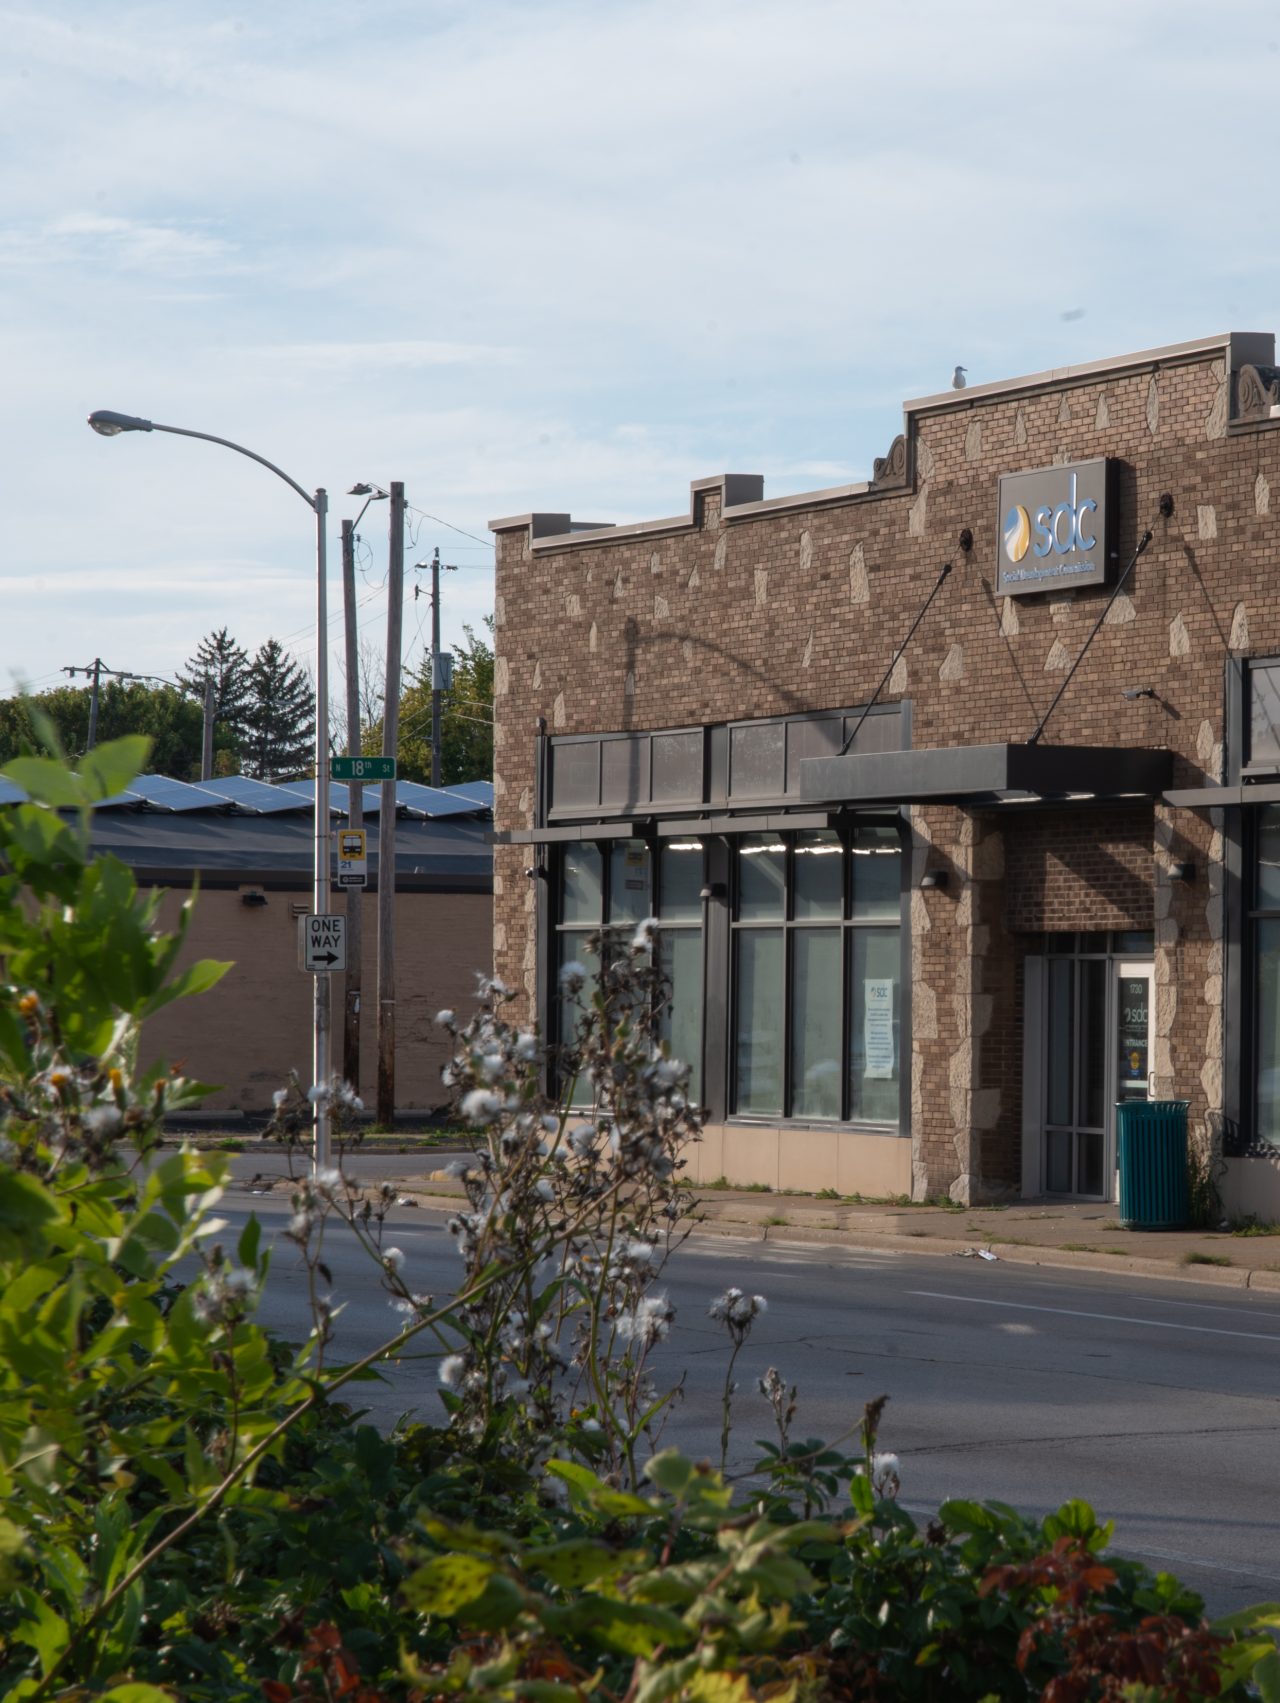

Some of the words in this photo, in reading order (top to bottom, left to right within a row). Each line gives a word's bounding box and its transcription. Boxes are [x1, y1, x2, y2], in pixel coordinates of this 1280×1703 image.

[1032, 472, 1097, 558] sdc
[335, 763, 341, 772] N
[351, 760, 372, 776] 18th
[382, 763, 391, 773] St
[311, 919, 341, 932] ONE
[311, 935, 341, 948] WAY
[1124, 1038, 1148, 1048] NTRANCE
